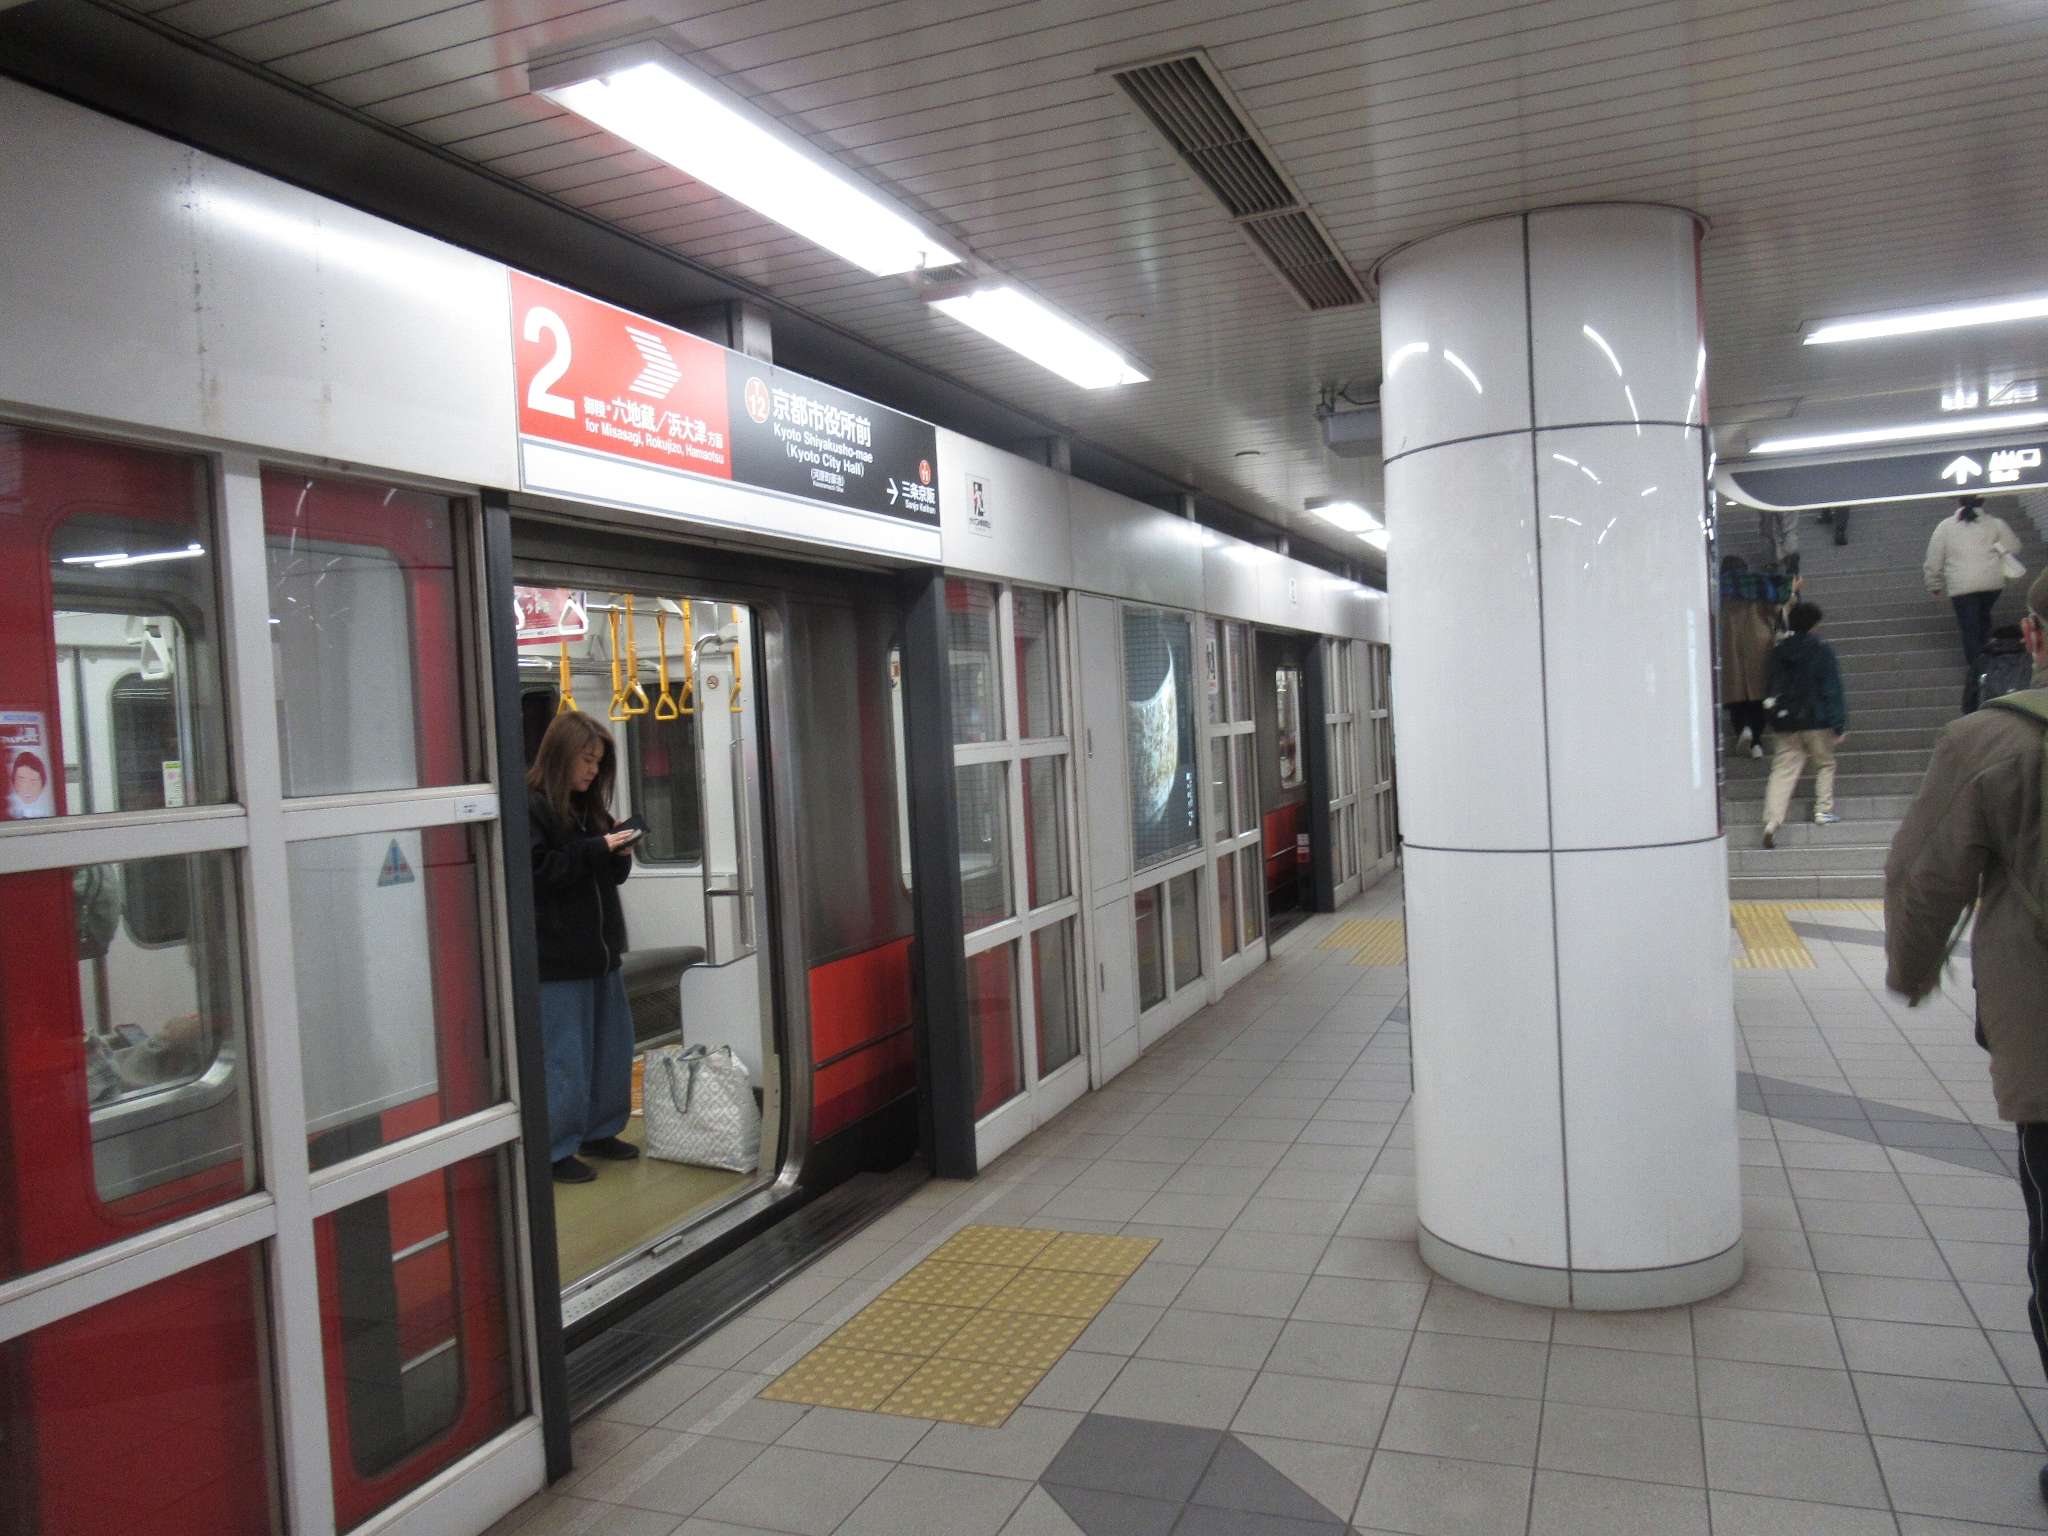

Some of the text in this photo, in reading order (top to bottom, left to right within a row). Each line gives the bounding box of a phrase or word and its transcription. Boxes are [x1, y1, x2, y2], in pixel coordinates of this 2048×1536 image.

[523, 306, 576, 420] 2
[585, 418, 600, 433] for
[601, 422, 644, 447] Misasagi,
[772, 388, 872, 447] 京都市役所前
[773, 422, 874, 464] Kyoto Shiyakusho-mae
[786, 441, 865, 478] (Kyoto City Hall)
